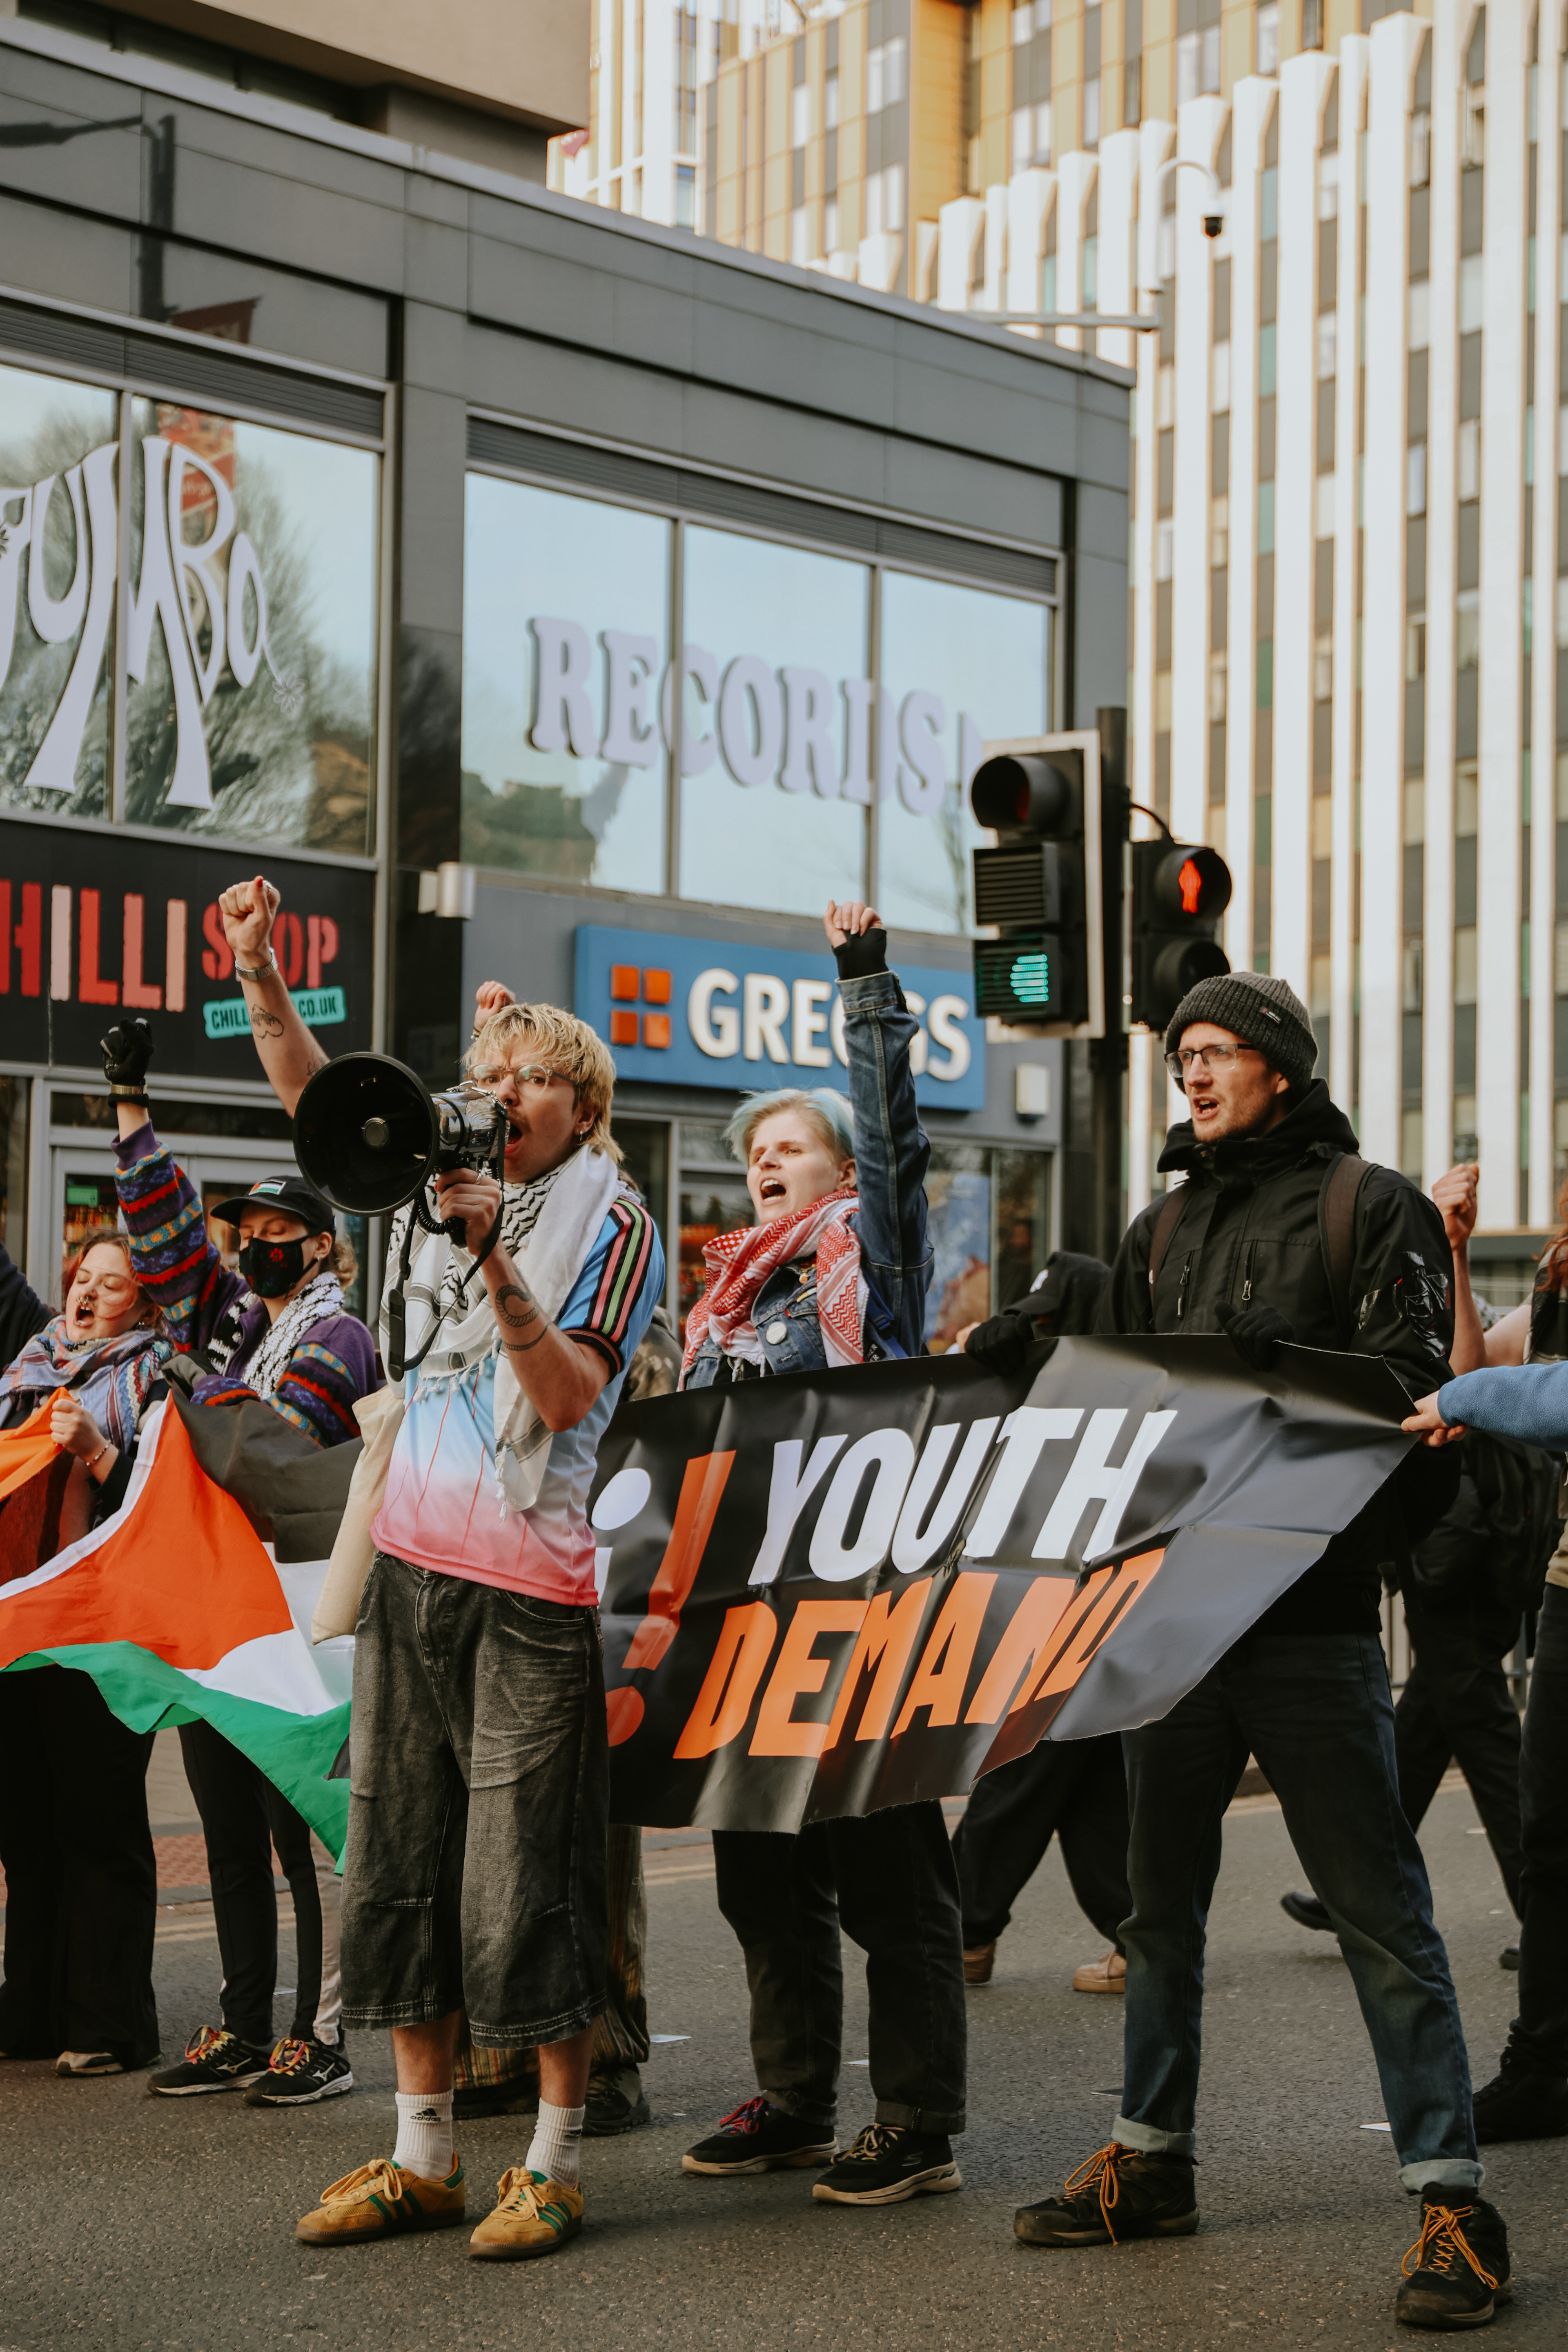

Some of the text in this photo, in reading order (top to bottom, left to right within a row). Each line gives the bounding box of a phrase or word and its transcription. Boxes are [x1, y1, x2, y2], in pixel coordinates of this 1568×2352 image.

[526, 616, 947, 815] RECORDS
[201, 902, 339, 989] SOP
[747, 1406, 1178, 1584] YOUTH
[672, 1547, 1166, 1759] DEMAND
